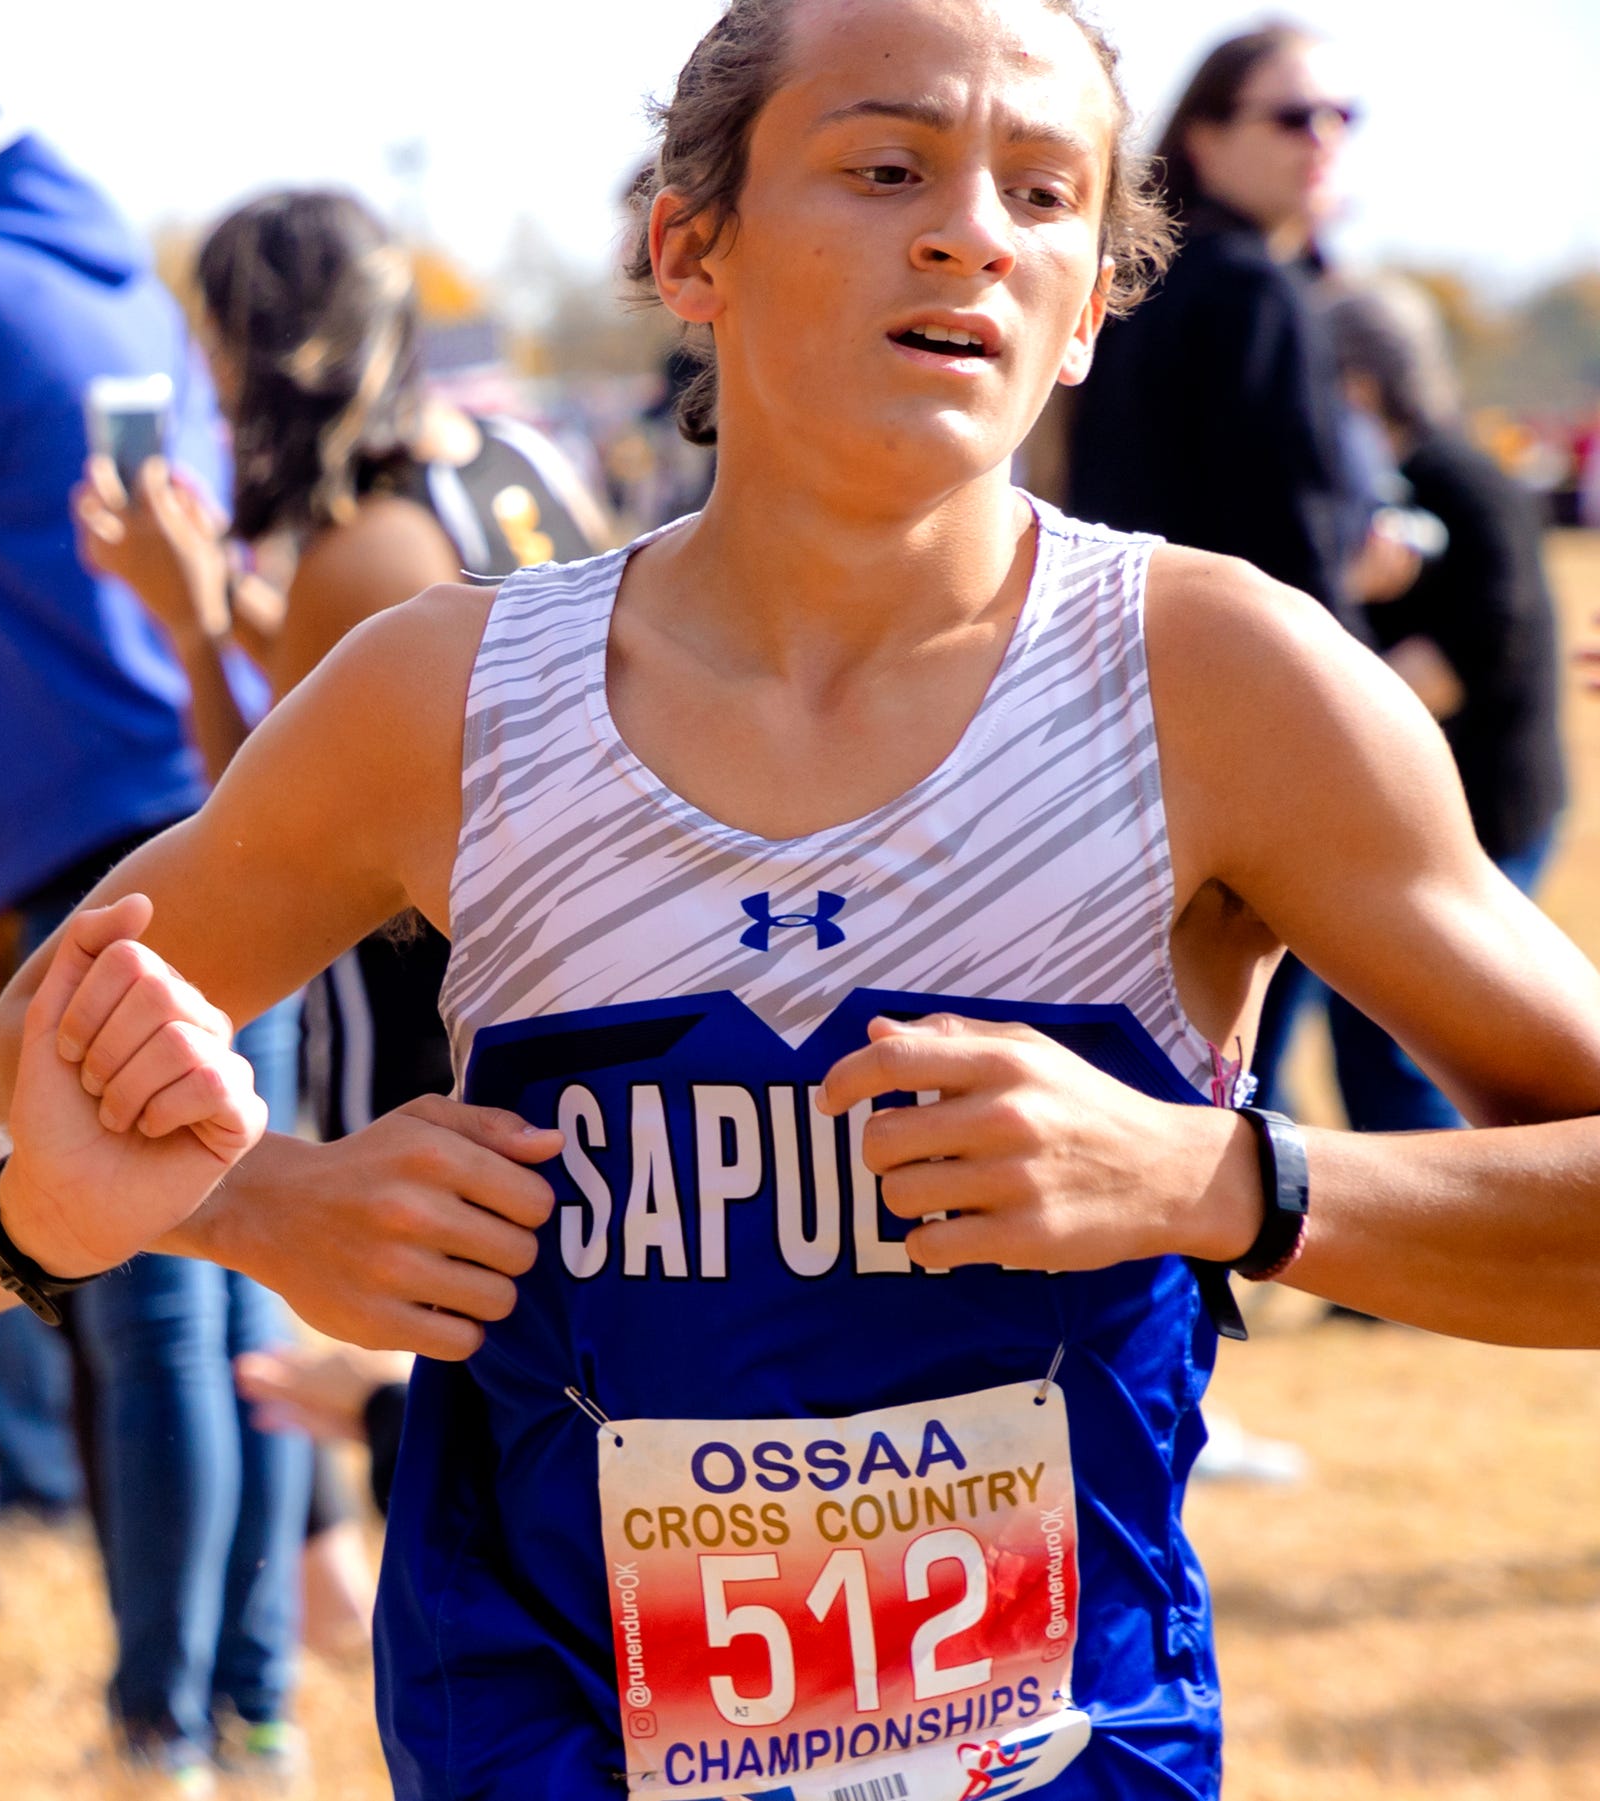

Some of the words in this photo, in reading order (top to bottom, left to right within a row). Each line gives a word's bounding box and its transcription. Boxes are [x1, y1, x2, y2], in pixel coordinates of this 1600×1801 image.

[556, 1083, 1067, 1280] SAPUL
[624, 1502, 791, 1550] CROSS
[816, 1462, 1045, 1542] COUNTRY
[691, 1419, 966, 1494] OSSAA
[614, 1561, 652, 1708] @runenduroOK
[697, 1527, 990, 1727] 512
[1039, 1506, 1069, 1640] @runenduroOK
[664, 1676, 1042, 1786] CHAMPIONSHIPS
